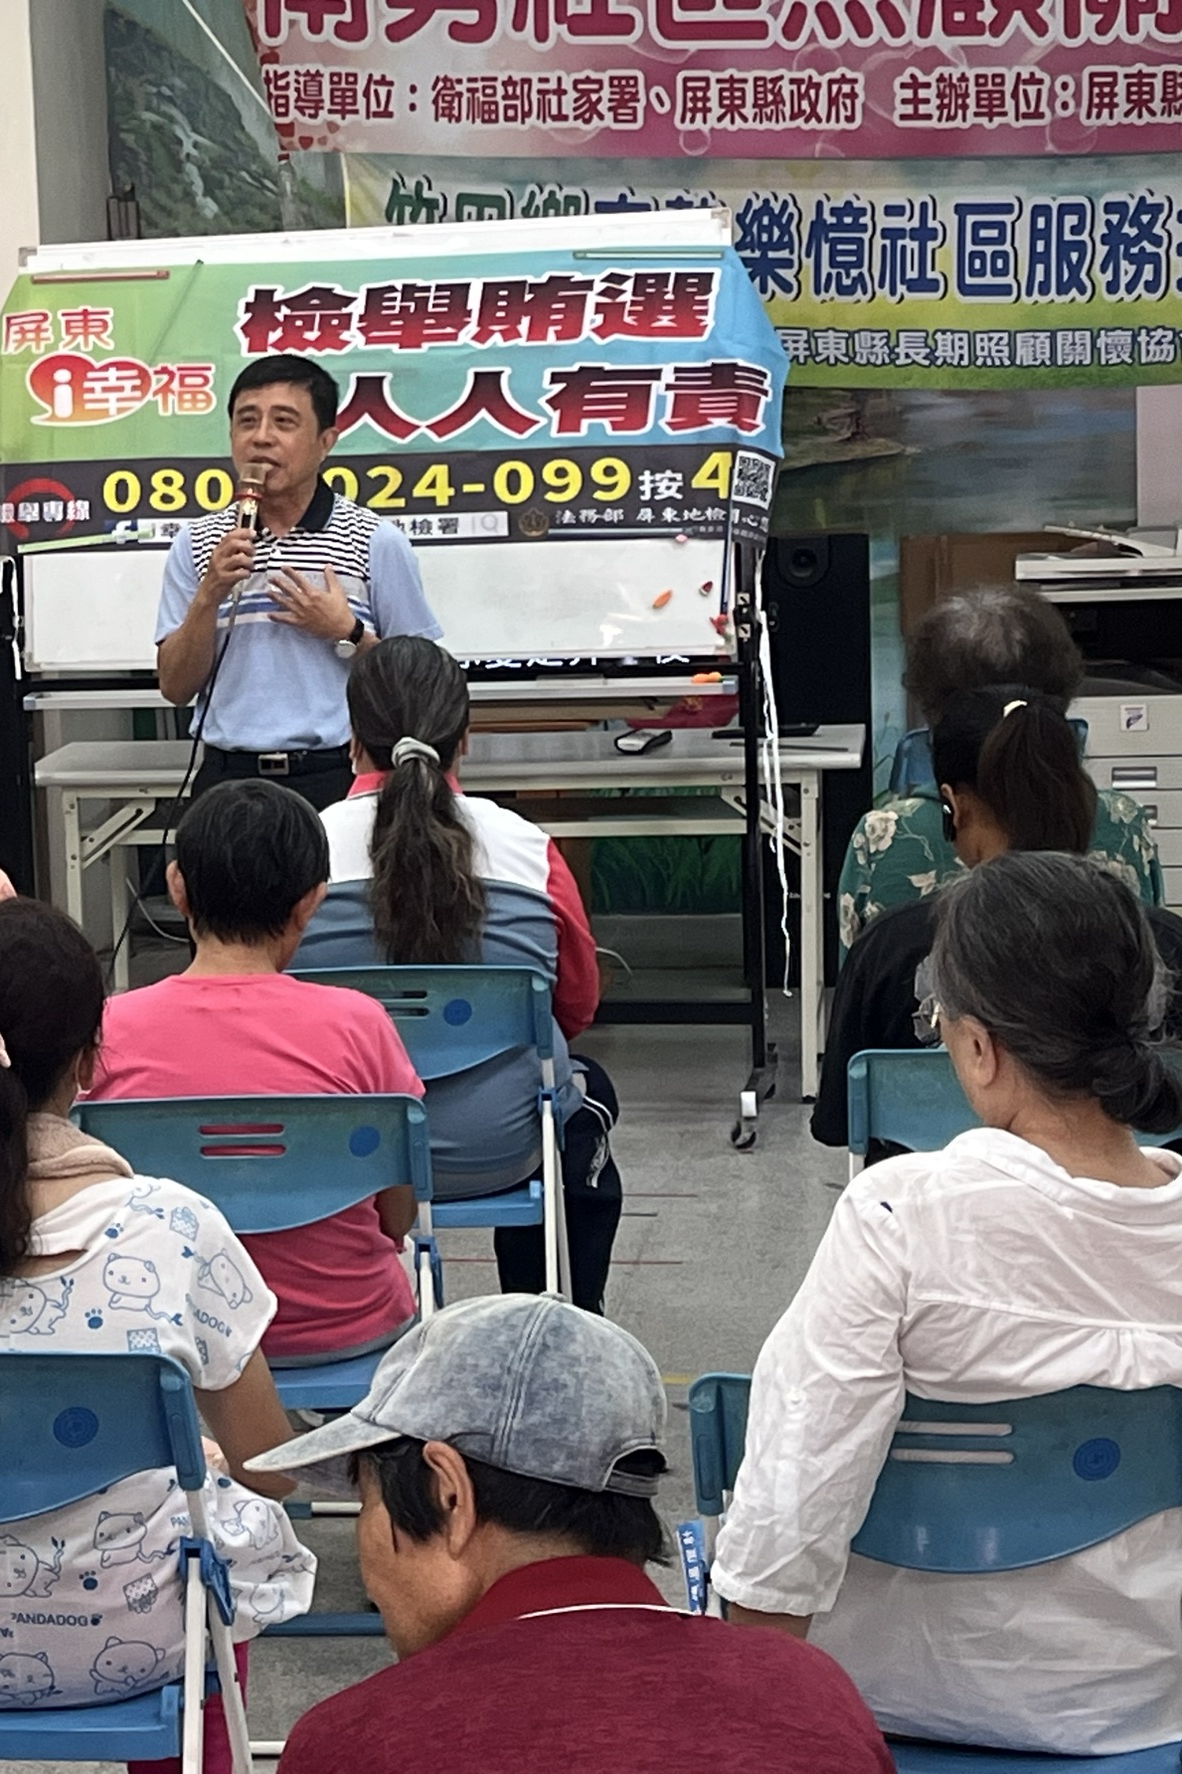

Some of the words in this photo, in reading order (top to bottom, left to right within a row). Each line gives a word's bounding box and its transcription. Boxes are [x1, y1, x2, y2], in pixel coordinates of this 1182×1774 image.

[3, 308, 113, 352] 屏東
[241, 271, 716, 354] 檢舉賄選
[781, 329, 1182, 367] 屏東縣長期照顧關懷協
[336, 361, 770, 440] 人人有責
